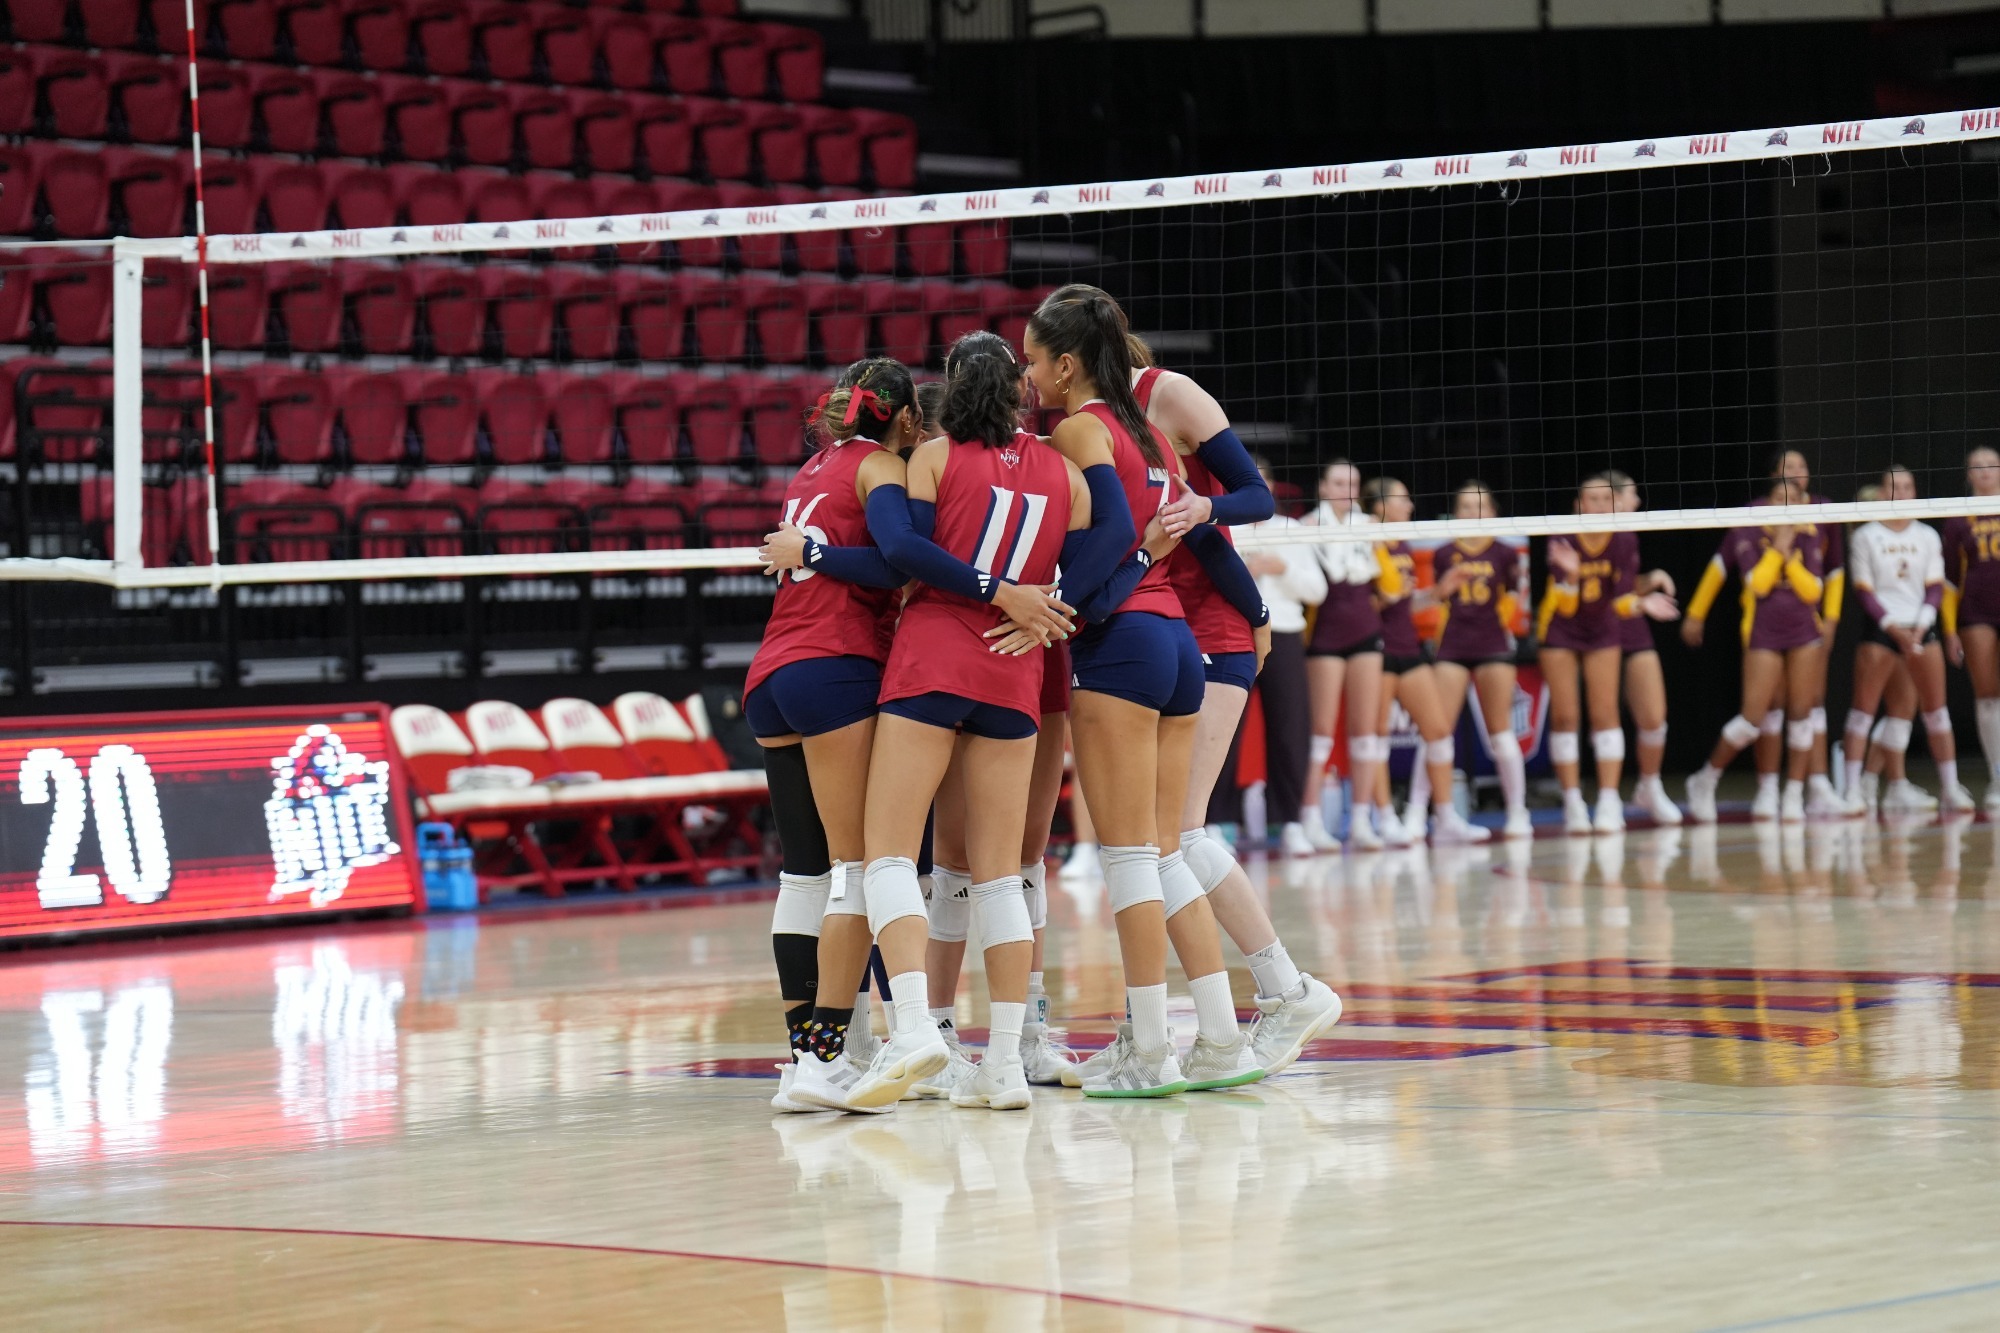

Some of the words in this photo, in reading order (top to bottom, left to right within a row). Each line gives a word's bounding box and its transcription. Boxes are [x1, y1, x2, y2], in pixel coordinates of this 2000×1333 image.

[965, 193, 999, 211] NJIT
[1078, 185, 1113, 203] NJIT
[1194, 175, 1229, 195] NJIT
[1312, 165, 1350, 186] NJIT
[1434, 156, 1473, 177] NJIT
[1559, 144, 1600, 166] NJIT
[1688, 133, 1731, 156] NJIT
[1822, 121, 1866, 144] NJIT
[970, 485, 1048, 585] 11
[18, 744, 172, 909] 20
